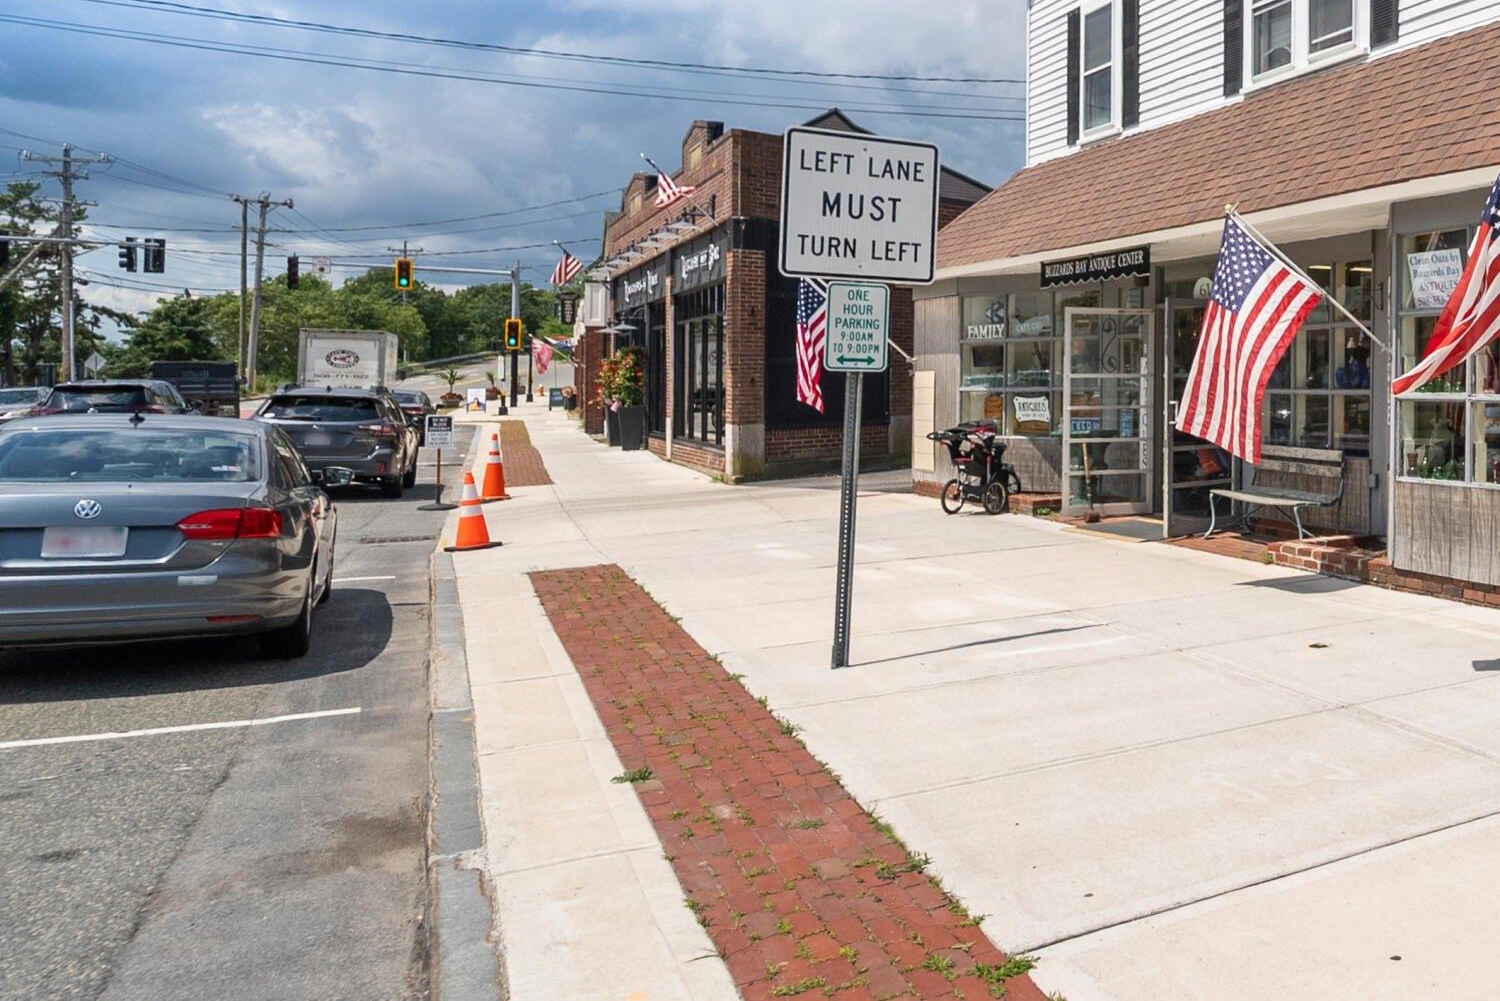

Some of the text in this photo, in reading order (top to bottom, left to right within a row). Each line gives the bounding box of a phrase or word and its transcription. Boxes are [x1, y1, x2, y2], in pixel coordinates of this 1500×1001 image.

[800, 148, 924, 182] LEFT LANE
[822, 191, 901, 222] MUST
[798, 234, 921, 263] TURN LEFT
[1045, 250, 1144, 277] BUZZARDS BAY ANTIQUE CENTER
[1431, 254, 1449, 263] Outs
[1450, 252, 1459, 263] by
[1413, 266, 1459, 278] Buzzards Bay
[848, 289, 869, 301] ONE
[1200, 282, 1210, 297] 61
[843, 303, 873, 315] HOUR
[834, 317, 879, 330] PARKING
[840, 331, 873, 342] 9:00AM
[967, 324, 1004, 338] FAMILY
[833, 342, 880, 354] TO 9:00PM
